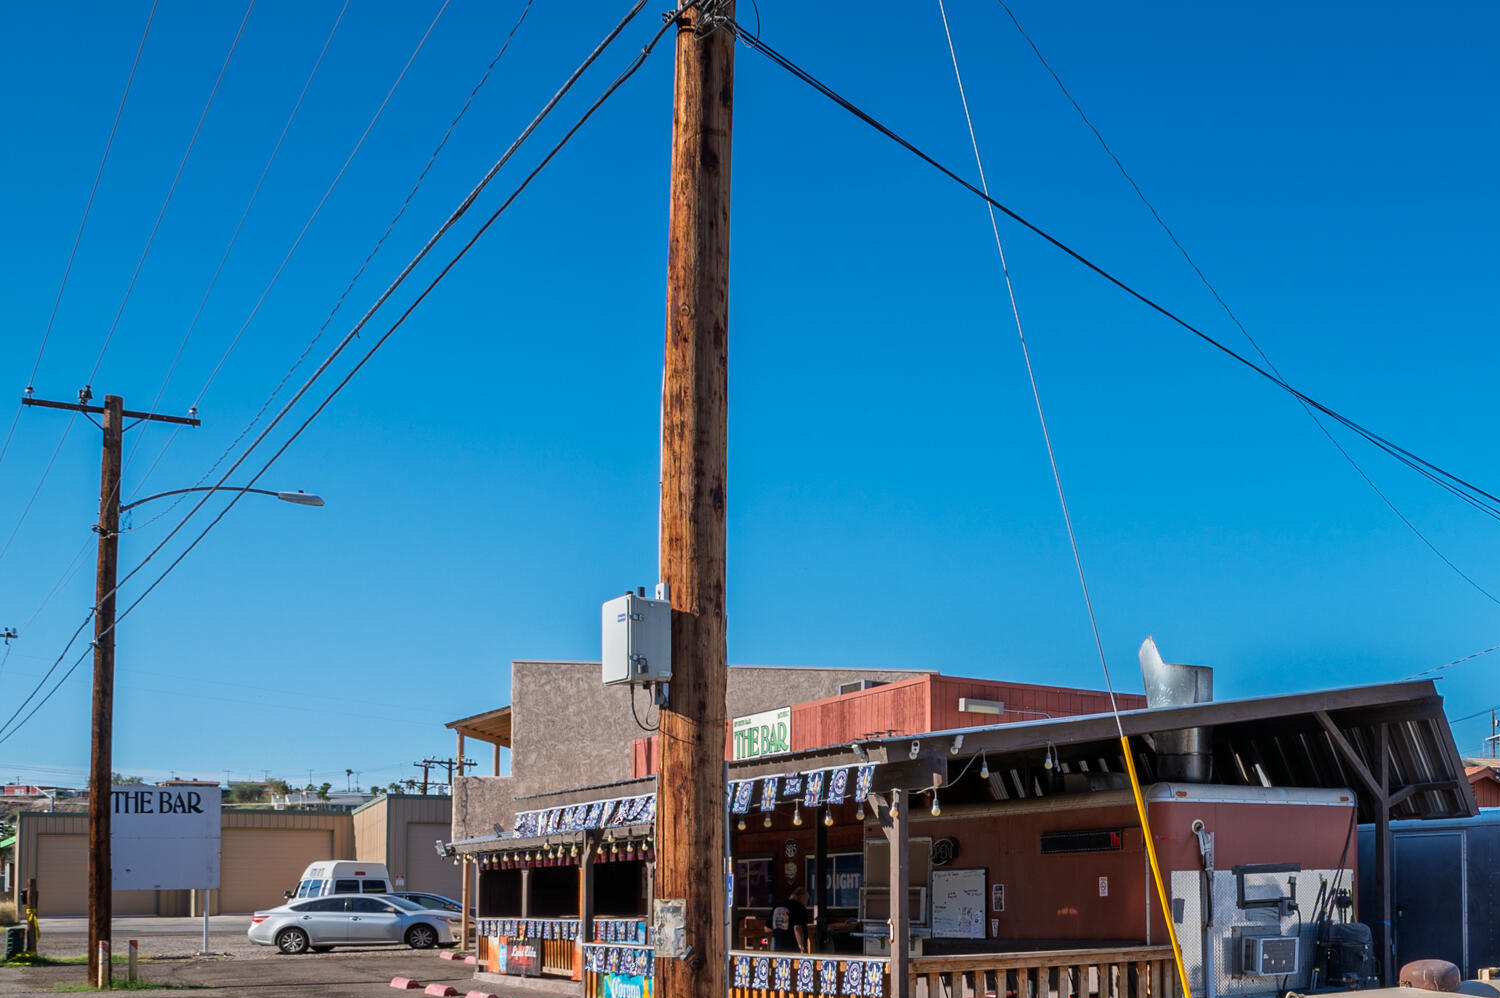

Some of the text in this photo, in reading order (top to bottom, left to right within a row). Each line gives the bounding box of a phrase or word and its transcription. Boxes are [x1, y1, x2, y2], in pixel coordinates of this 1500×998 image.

[734, 722, 789, 760] THE BAR
[111, 791, 204, 814] THE BAR
